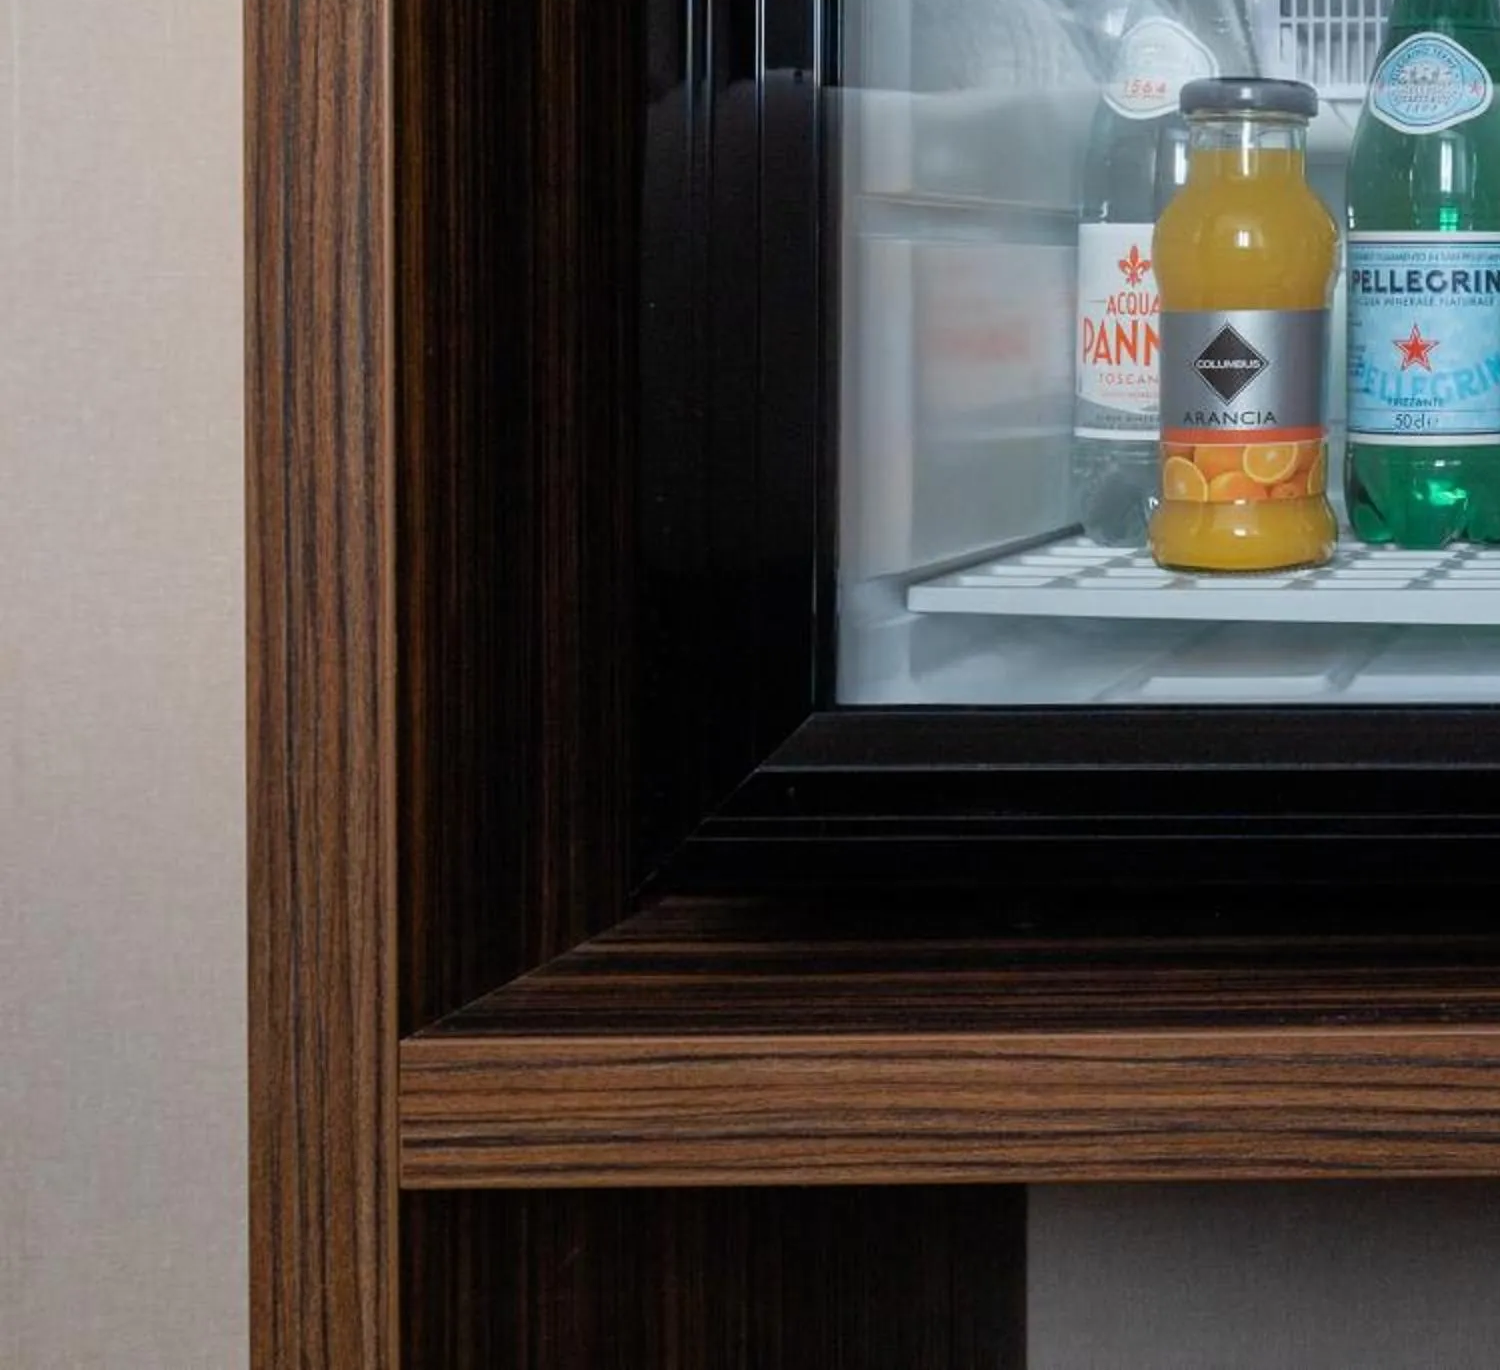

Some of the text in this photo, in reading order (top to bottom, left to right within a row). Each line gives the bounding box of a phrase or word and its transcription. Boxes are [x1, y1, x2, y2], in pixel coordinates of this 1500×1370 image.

[1107, 291, 1161, 315] ACQUA
[1082, 317, 1160, 365] PANN
[1098, 373, 1160, 385] TOSCAN
[1183, 411, 1278, 426] ARANCIA
